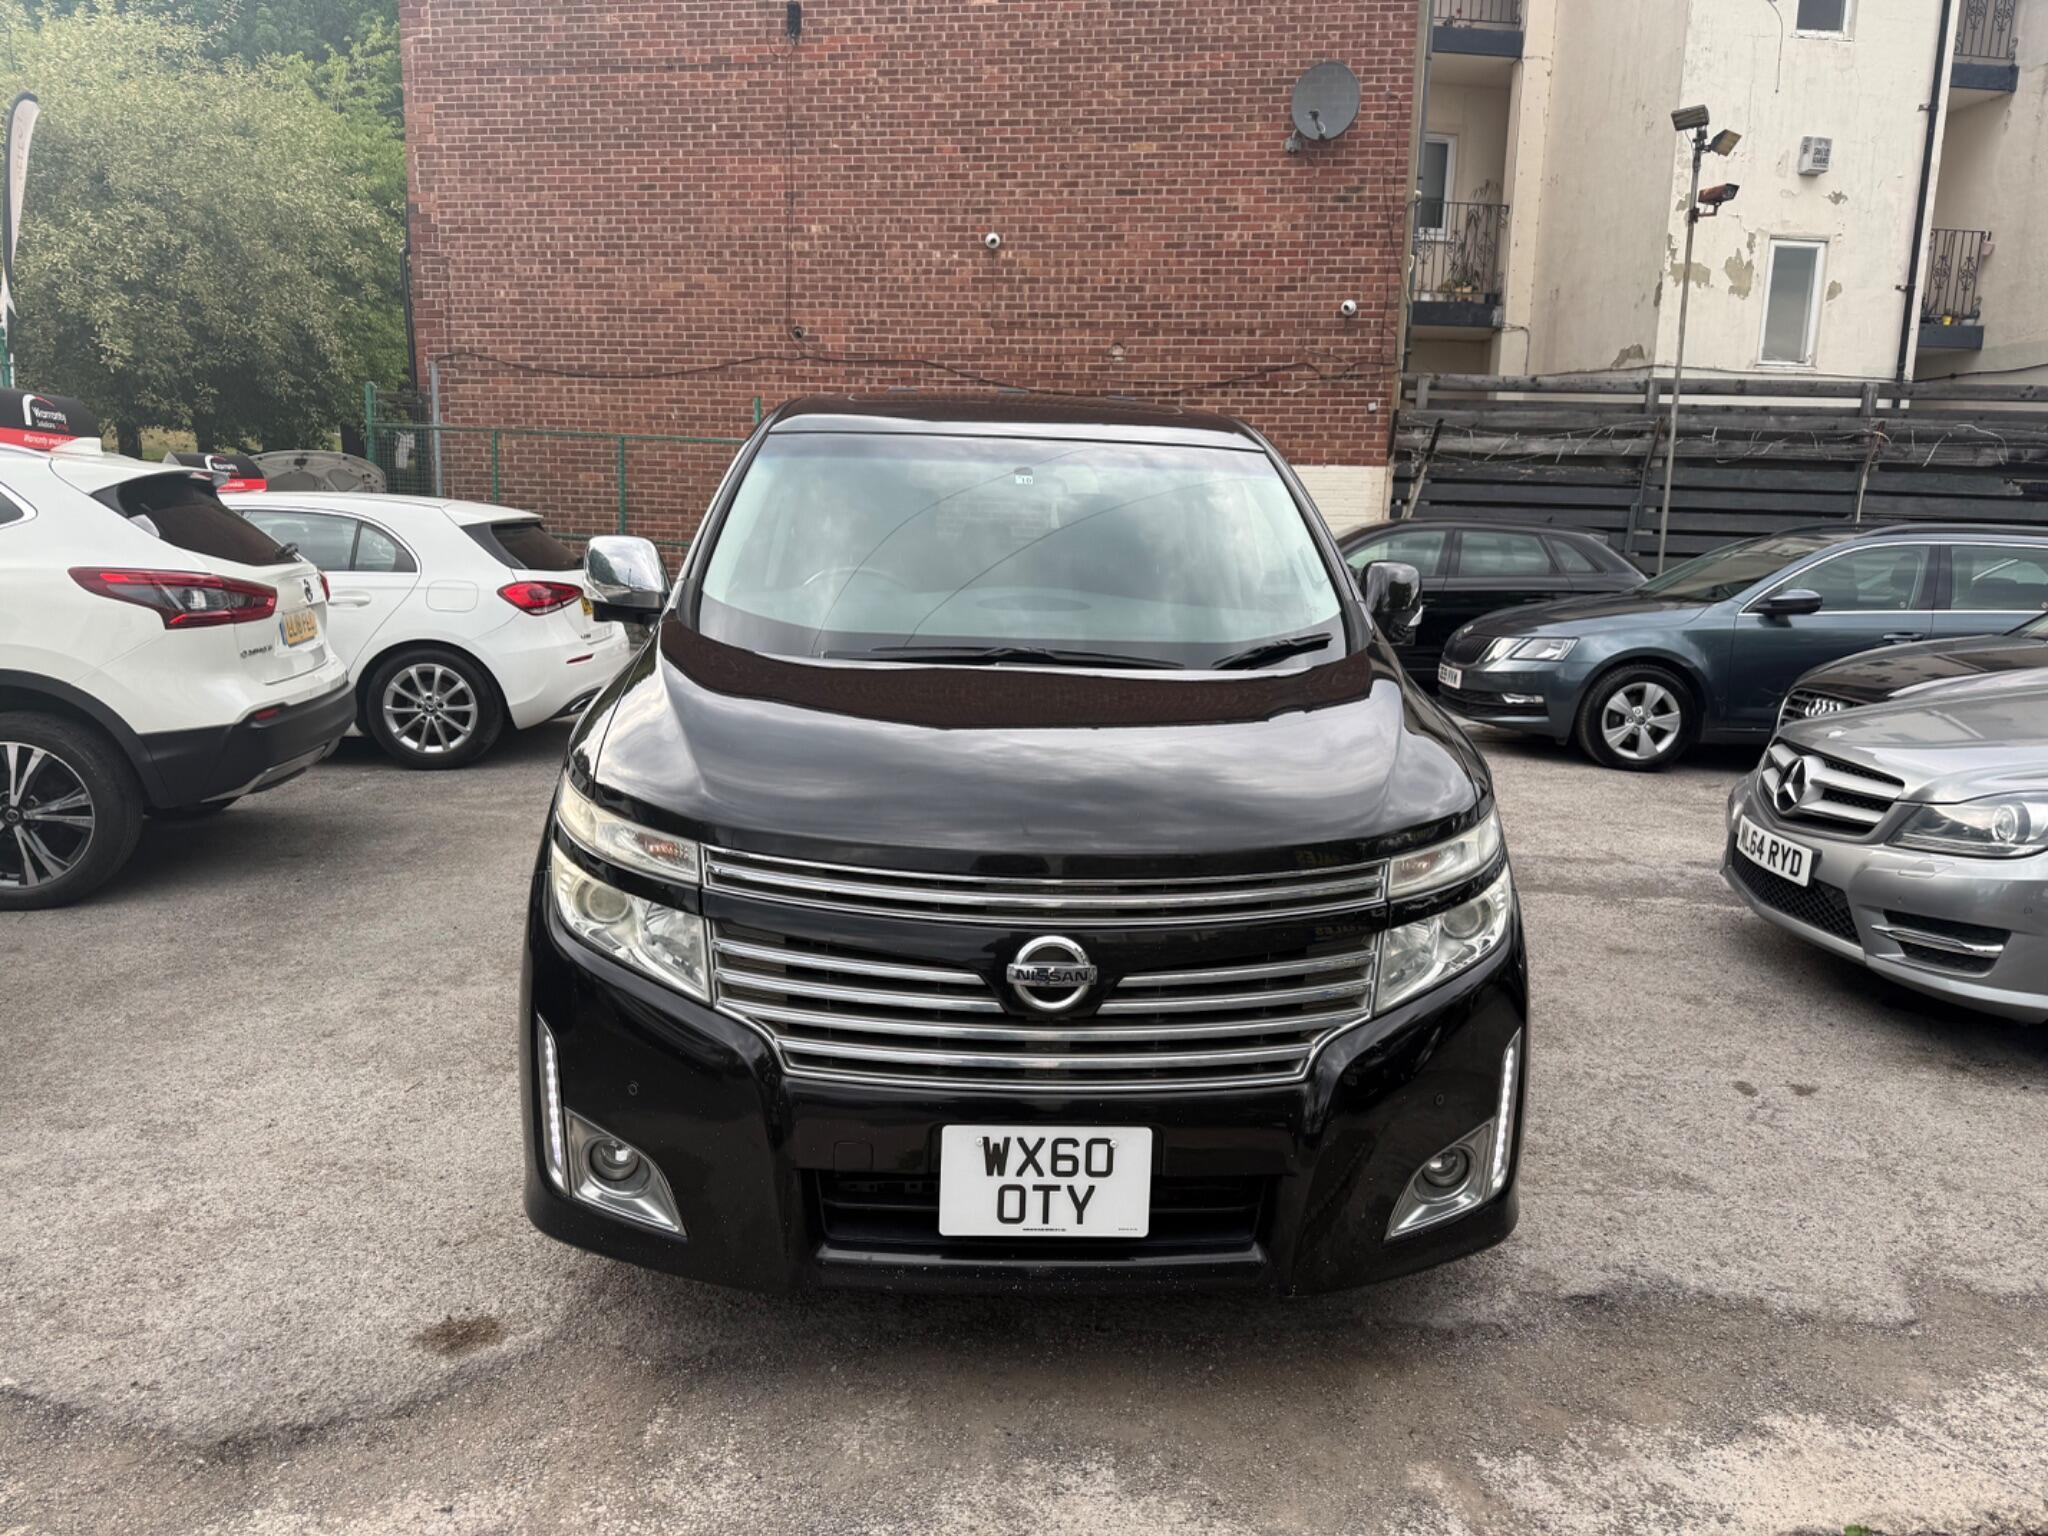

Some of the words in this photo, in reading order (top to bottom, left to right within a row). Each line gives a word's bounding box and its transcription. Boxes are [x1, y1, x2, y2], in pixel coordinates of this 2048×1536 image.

[1767, 839, 1803, 877] RYD
[1014, 969, 1089, 982] NISSAN
[982, 1136, 1114, 1178] WX60
[997, 1184, 1096, 1225] OTY
